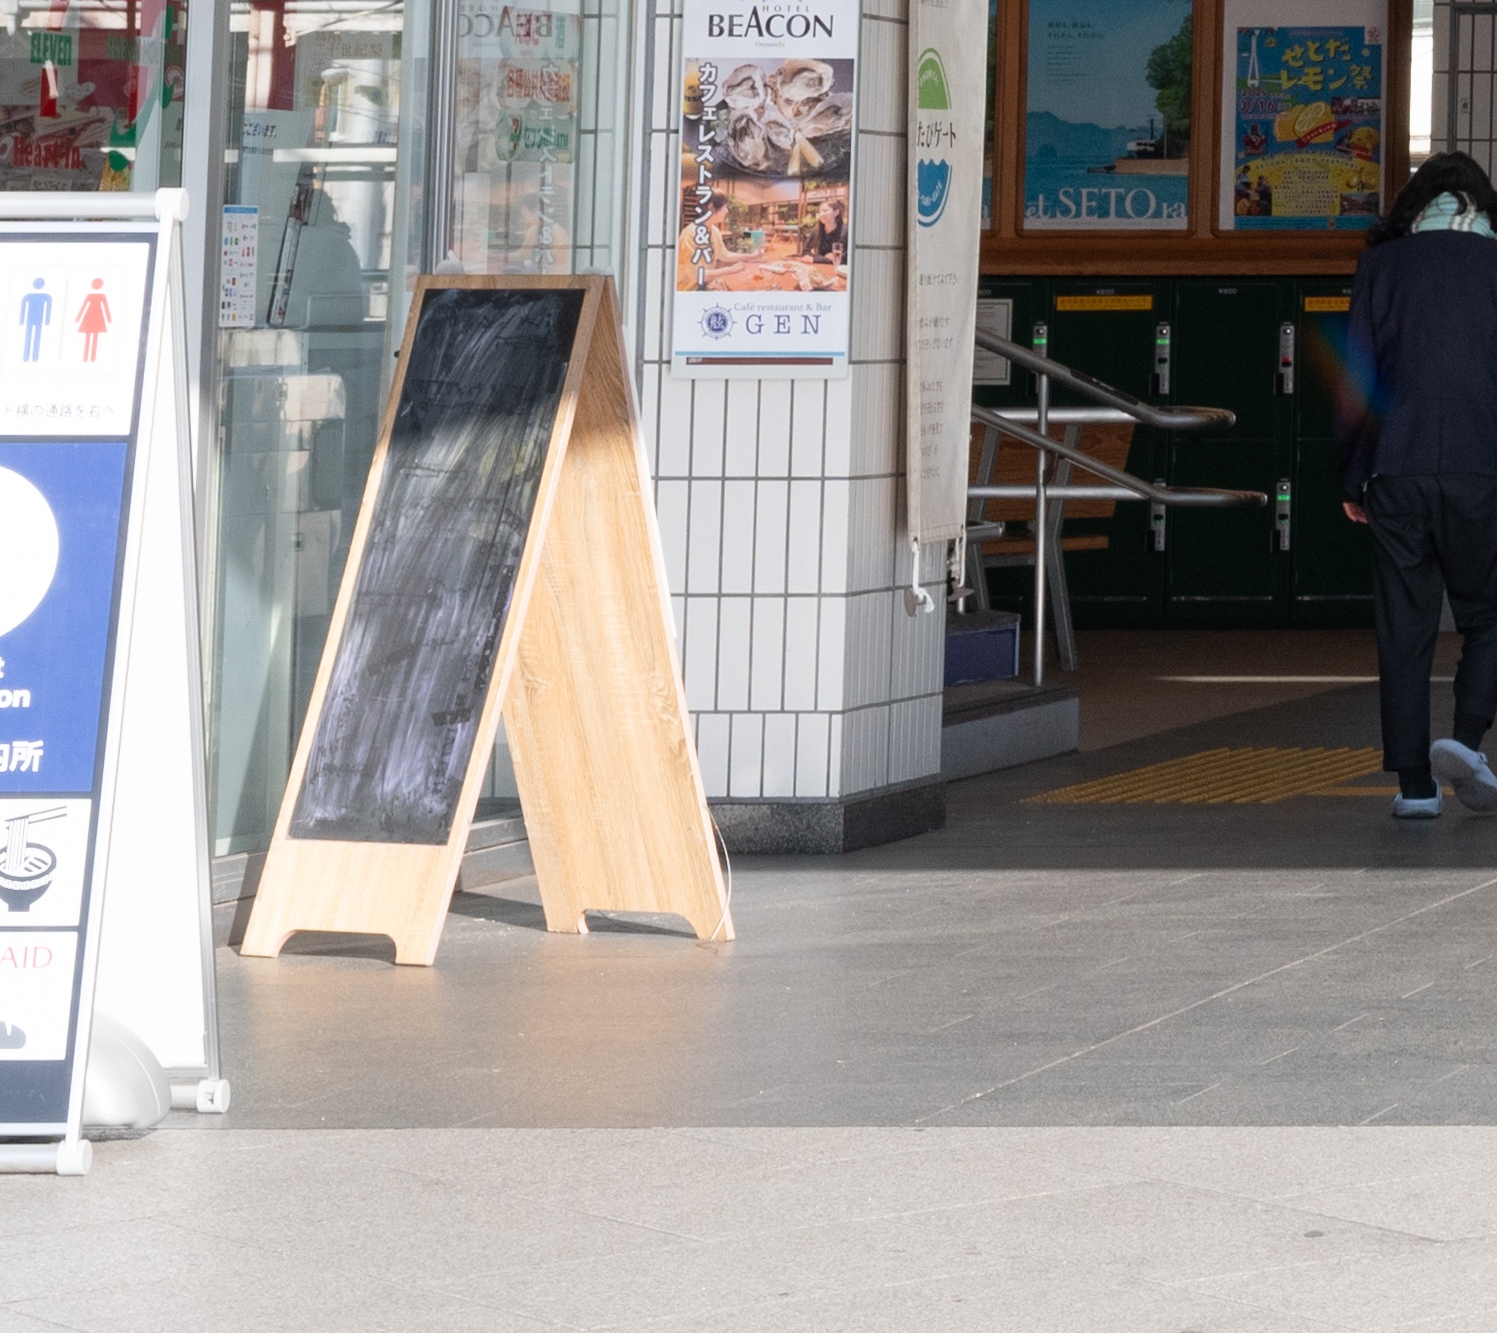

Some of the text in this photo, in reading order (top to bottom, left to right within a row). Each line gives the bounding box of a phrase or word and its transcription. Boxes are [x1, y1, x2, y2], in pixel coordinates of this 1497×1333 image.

[707, 5, 835, 39] BEACON
[761, 4, 811, 13] HOTEL
[1281, 37, 1352, 67] せとだ
[1056, 187, 1157, 220] SETO
[745, 314, 823, 335] GEN
